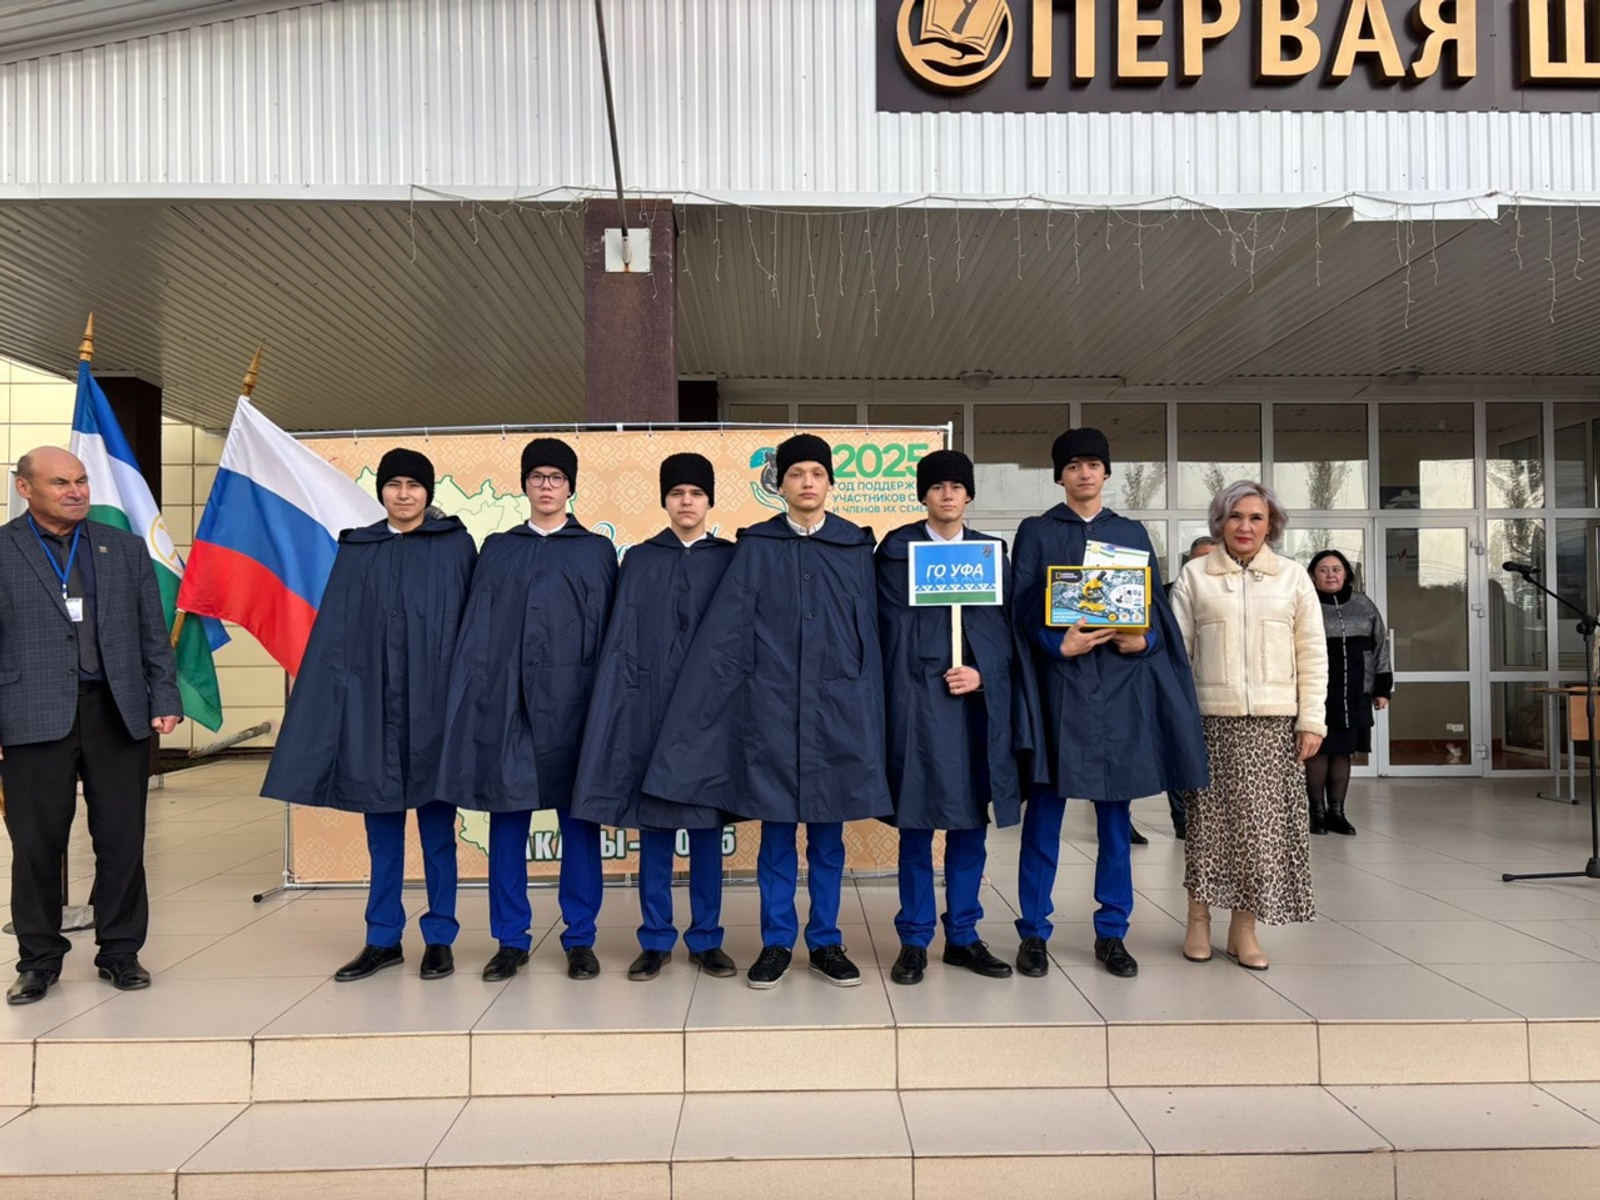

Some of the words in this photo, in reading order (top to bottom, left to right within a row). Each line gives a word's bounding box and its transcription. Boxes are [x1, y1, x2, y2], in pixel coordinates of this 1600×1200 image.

[1031, 0, 1477, 79] ПЕРВАЯ
[832, 443, 929, 478] 2025
[857, 481, 915, 491] ПОДДЕРЖ
[832, 493, 906, 502] УЧАСТНИКОВ
[842, 505, 880, 514] ЧЛЕНОВ
[883, 504, 897, 513] ИХ
[899, 504, 928, 513] СЕМЕ
[926, 564, 947, 578] ГО
[950, 563, 984, 578] УФА
